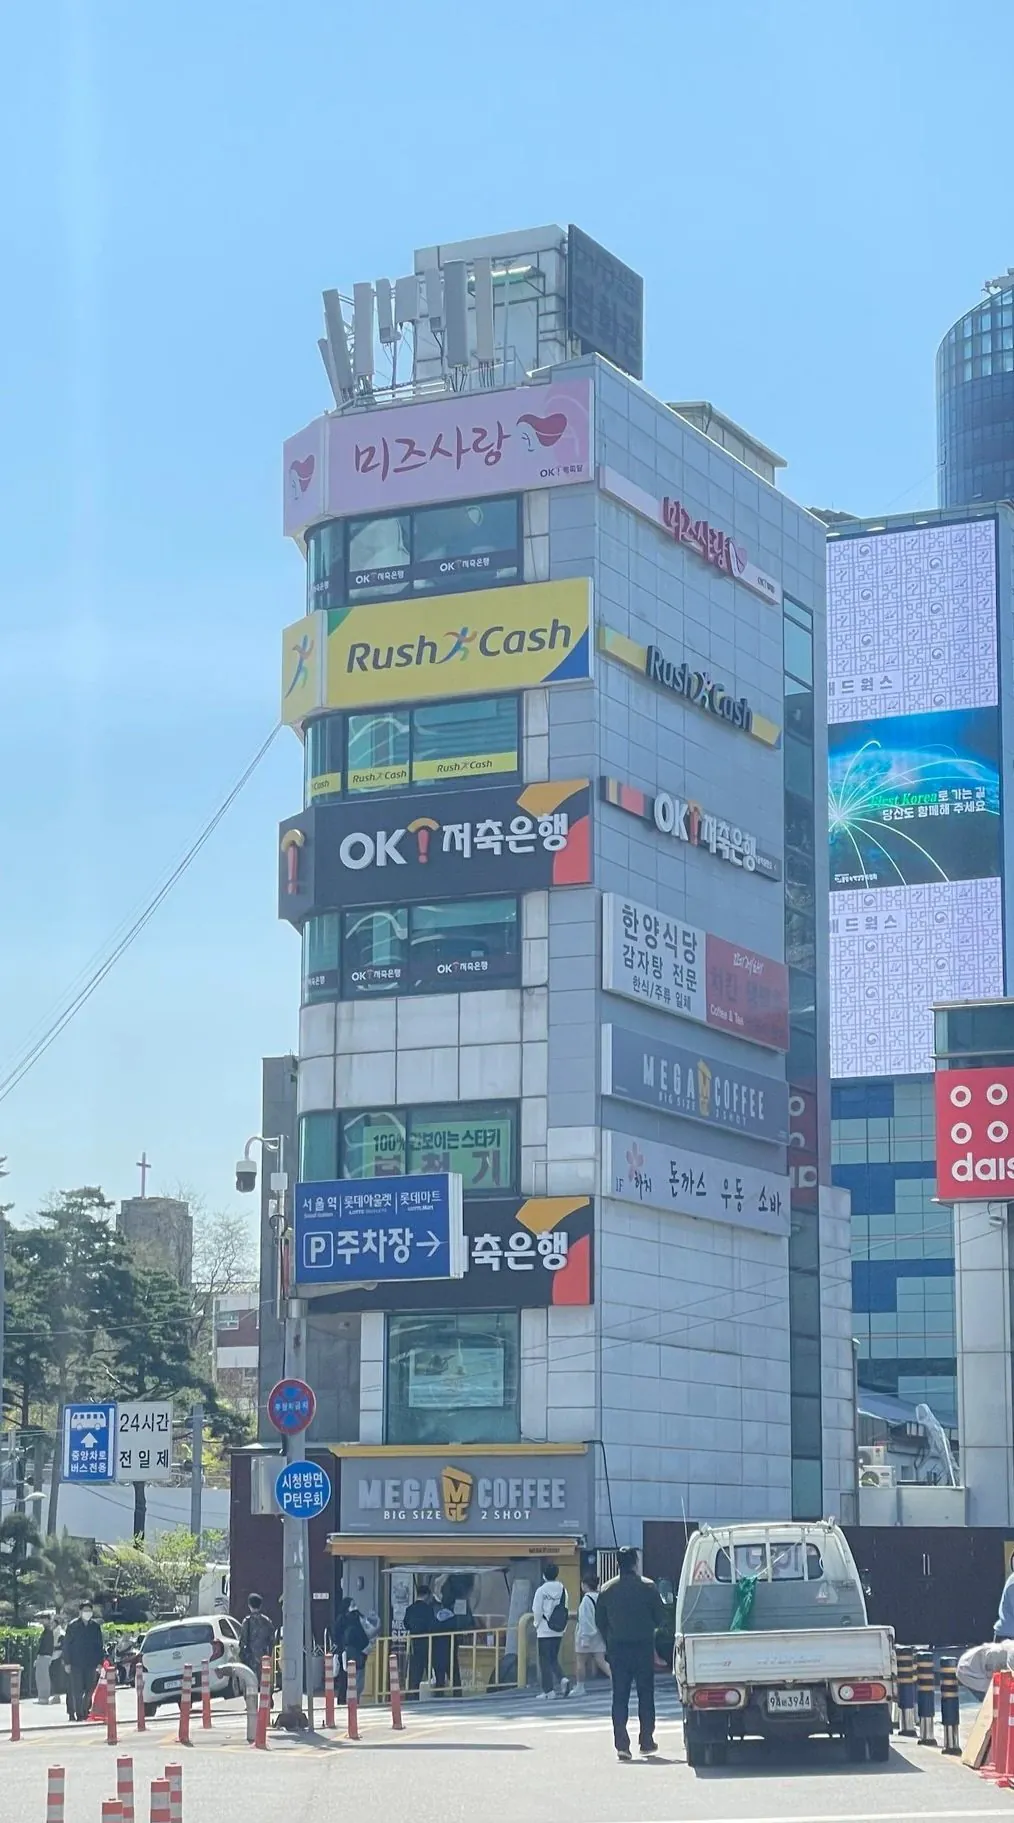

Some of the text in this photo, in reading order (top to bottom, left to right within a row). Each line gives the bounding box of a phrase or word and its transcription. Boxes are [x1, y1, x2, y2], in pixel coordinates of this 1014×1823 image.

[355, 421, 511, 481] 미즈사랑
[347, 619, 571, 673] Rush Cash
[647, 645, 753, 732] Rush Cash
[352, 769, 407, 783] Rush Cash
[437, 759, 493, 773] Rush Cash
[951, 788, 972, 801] 가는
[883, 806, 915, 821] 당신도
[954, 800, 986, 814] 주세요
[443, 812, 569, 858] 저축은행
[622, 904, 698, 965] 한양식당
[622, 943, 663, 980] 감자탕
[673, 963, 697, 993] 전문
[633, 975, 671, 1004] 한식/주류
[643, 1053, 765, 1120] MEGA COFFEE
[668, 1160, 782, 1216] 돈까스 우동 소바
[303, 1190, 442, 1212] 서울역 롯데아울렛 롯데마트
[337, 1227, 414, 1265] 주차장
[120, 1413, 169, 1432] 24시간
[71, 1450, 107, 1461] 중앙차로
[71, 1462, 107, 1473] 버스전용
[282, 1472, 323, 1489] 시청방면
[283, 1491, 323, 1509] P턴우회
[358, 1479, 440, 1509] MEGA
[477, 1478, 566, 1509] COFFEE
[384, 1510, 531, 1520] BIG SIZE 2 SHOT
